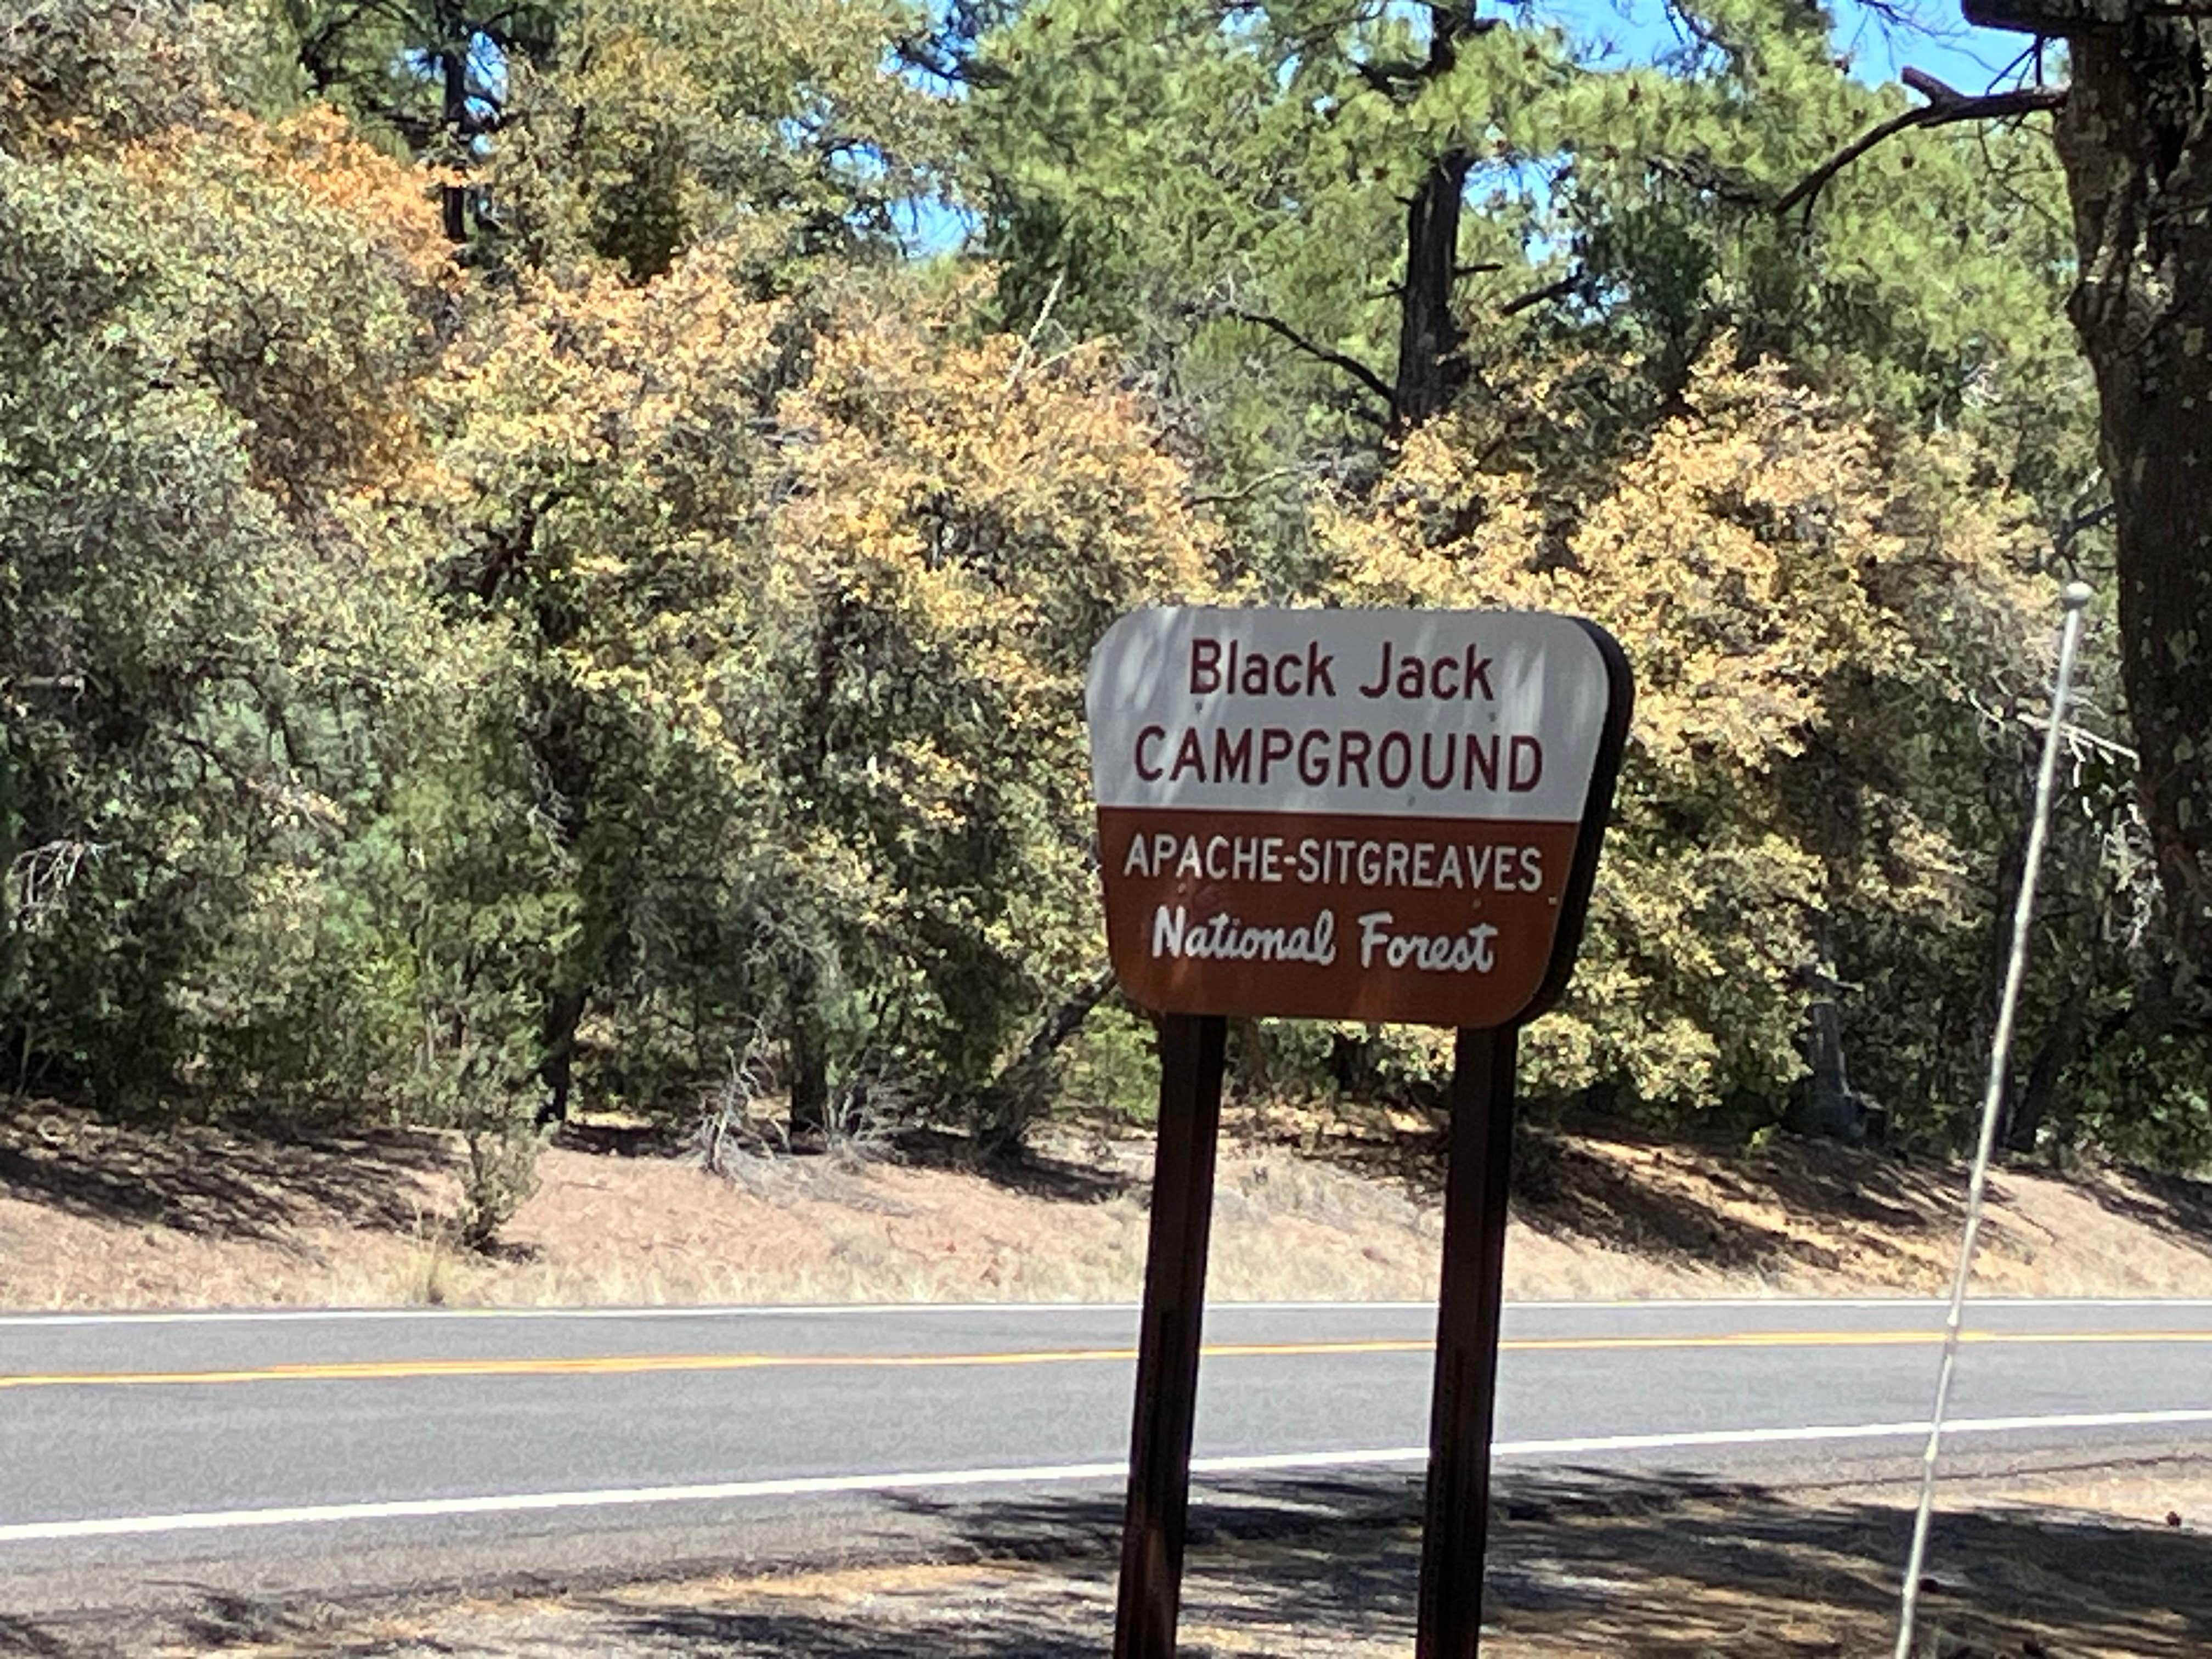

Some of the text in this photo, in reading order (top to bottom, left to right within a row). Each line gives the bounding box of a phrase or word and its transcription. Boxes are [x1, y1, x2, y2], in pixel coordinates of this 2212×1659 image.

[1189, 638, 1494, 701] Black Jack
[1134, 725, 1544, 793] CAMPGROUND
[1124, 833, 1543, 893] APACHE-SITGREAVES
[1152, 905, 1498, 974] National Forest
